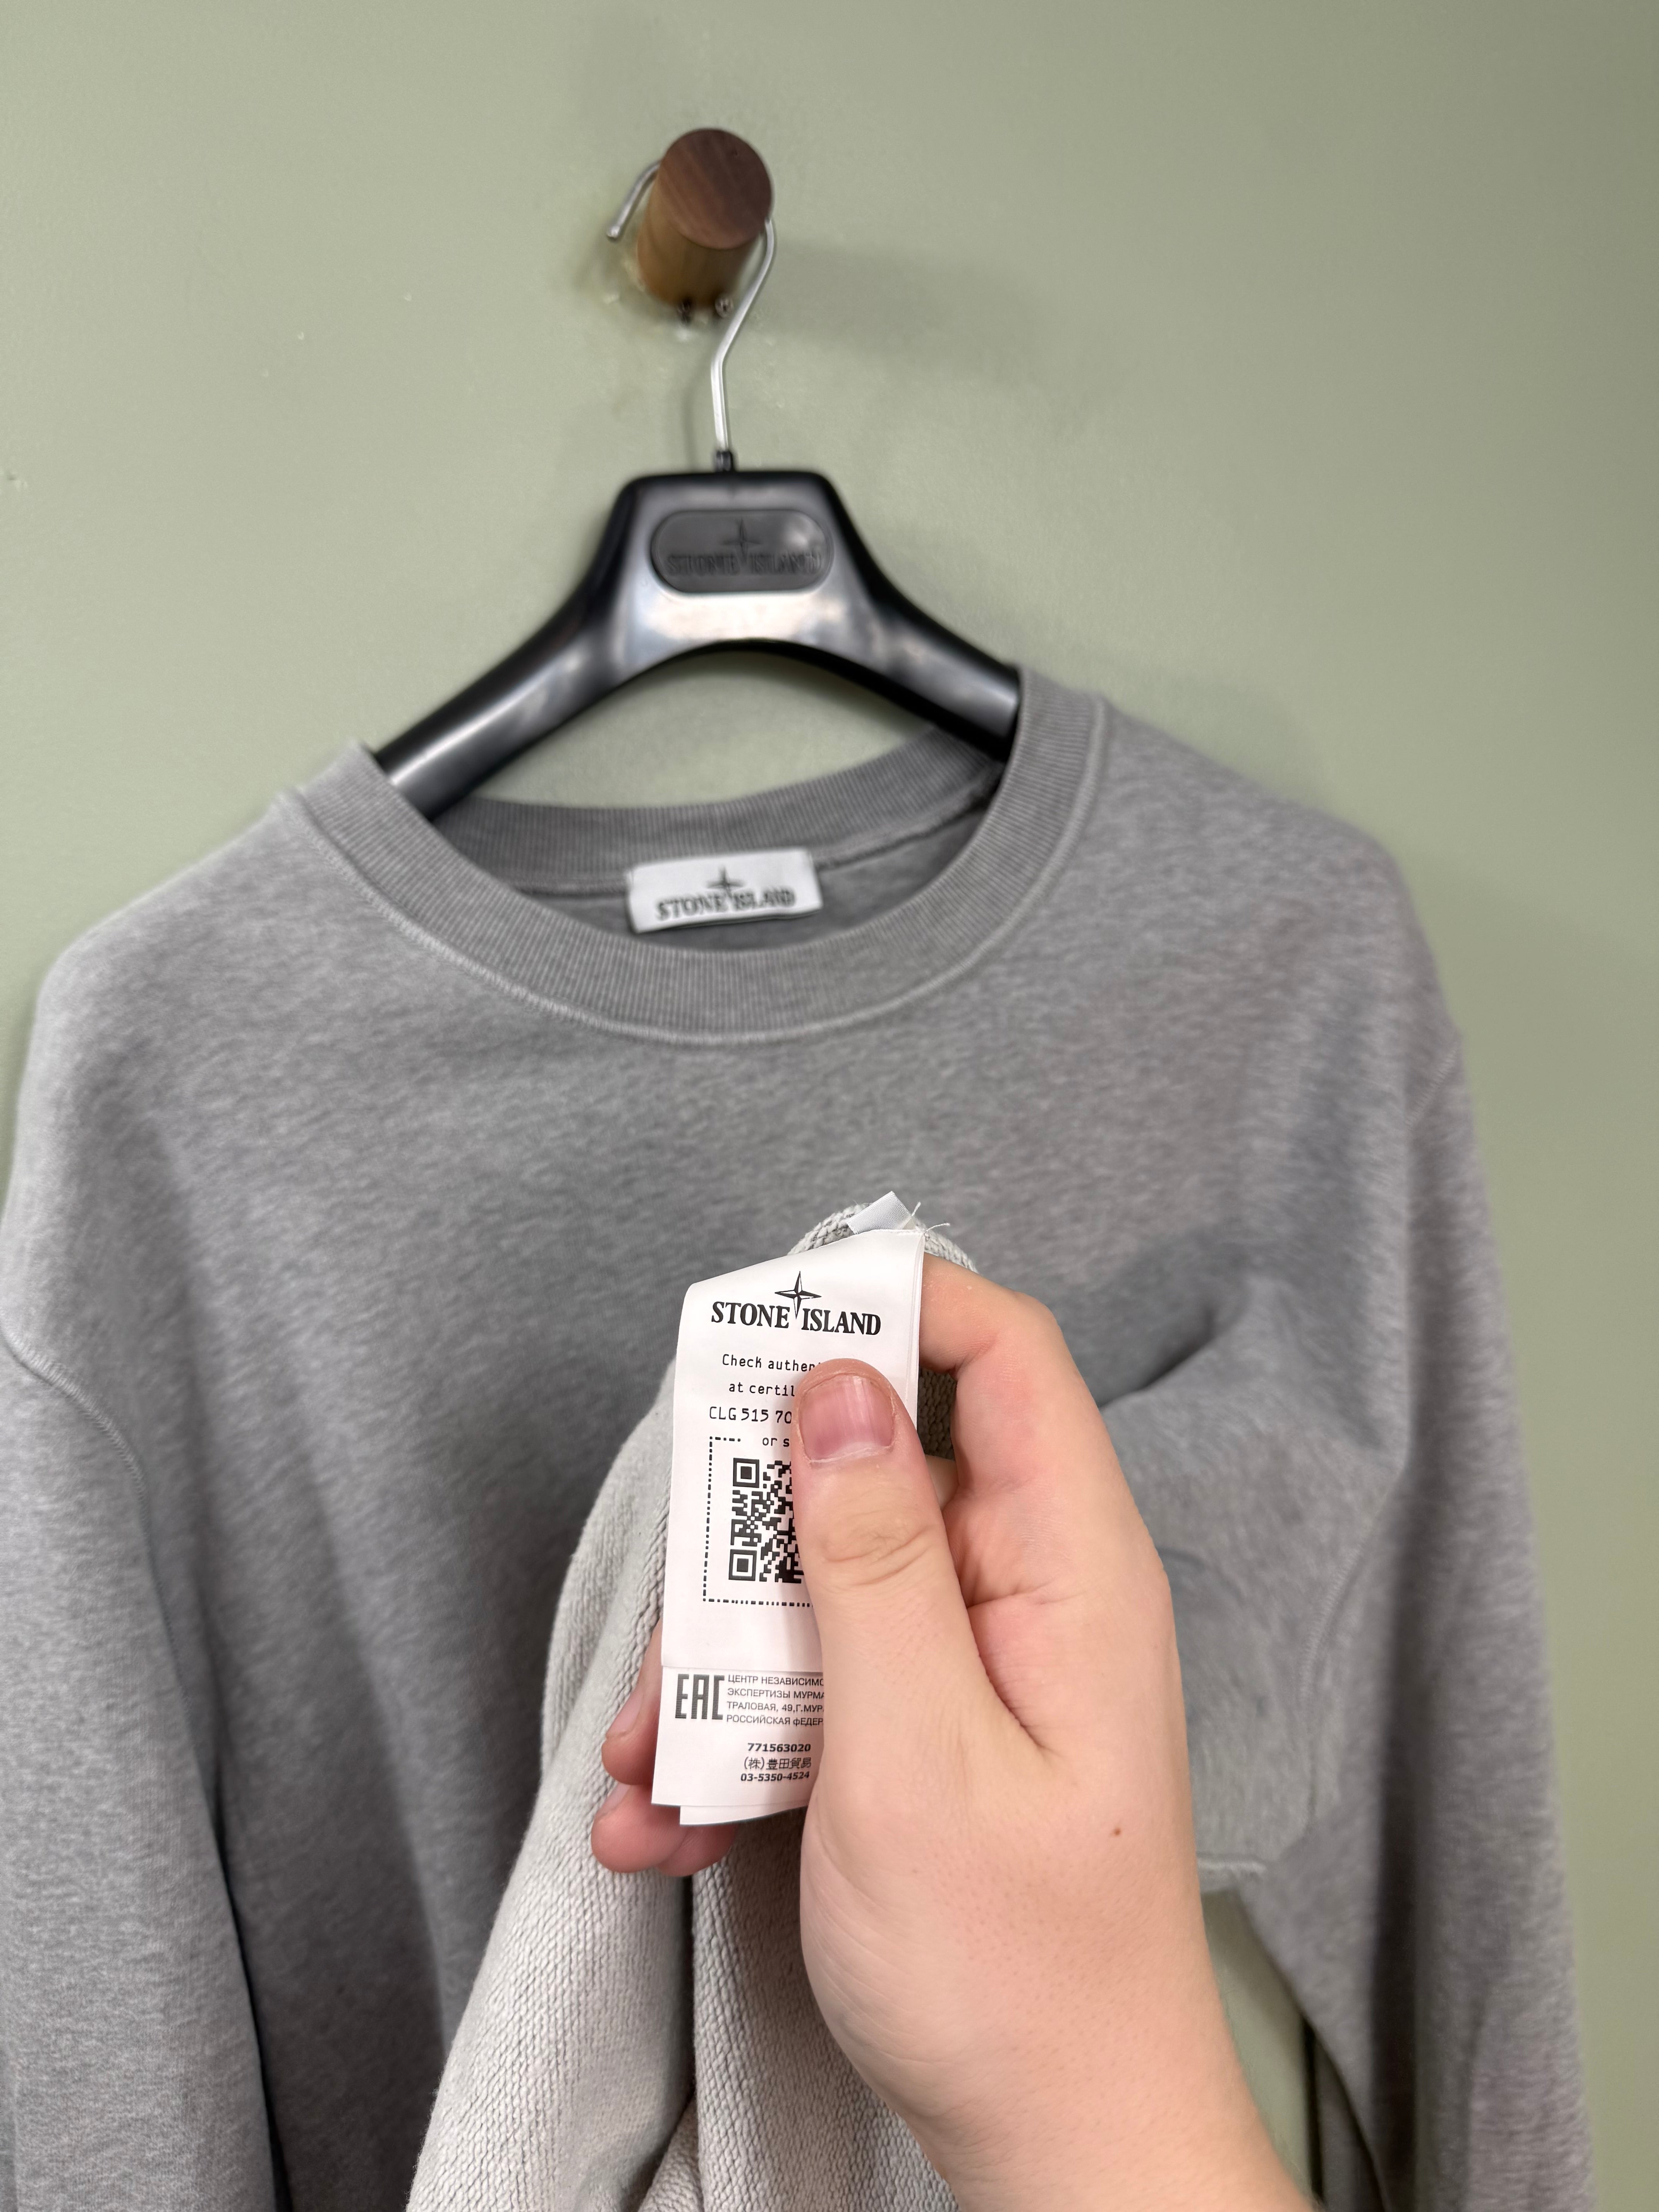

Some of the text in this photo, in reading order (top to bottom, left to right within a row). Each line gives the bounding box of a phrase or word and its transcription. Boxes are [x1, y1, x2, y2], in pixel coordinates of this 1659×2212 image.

[657, 888, 795, 920] STONE ISLAND
[711, 1302, 881, 1335] STONE ISLAND
[723, 1354, 821, 1372] Check authen
[729, 1382, 744, 1393] at
[709, 1407, 736, 1420] CLG
[741, 1408, 769, 1422] 515
[763, 1437, 777, 1446] or
[728, 1674, 758, 1683] ЦЕНТР
[727, 1688, 790, 1698] ЭКСПЕРТИЗЫ
[727, 1701, 824, 1713] ТРАЛОВАЯ, 49,Г.МУР
[726, 1715, 790, 1724] РОССИЙСКАЯ
[747, 1743, 811, 1752] 771563020
[740, 1771, 810, 1781] 03-5350-4524
